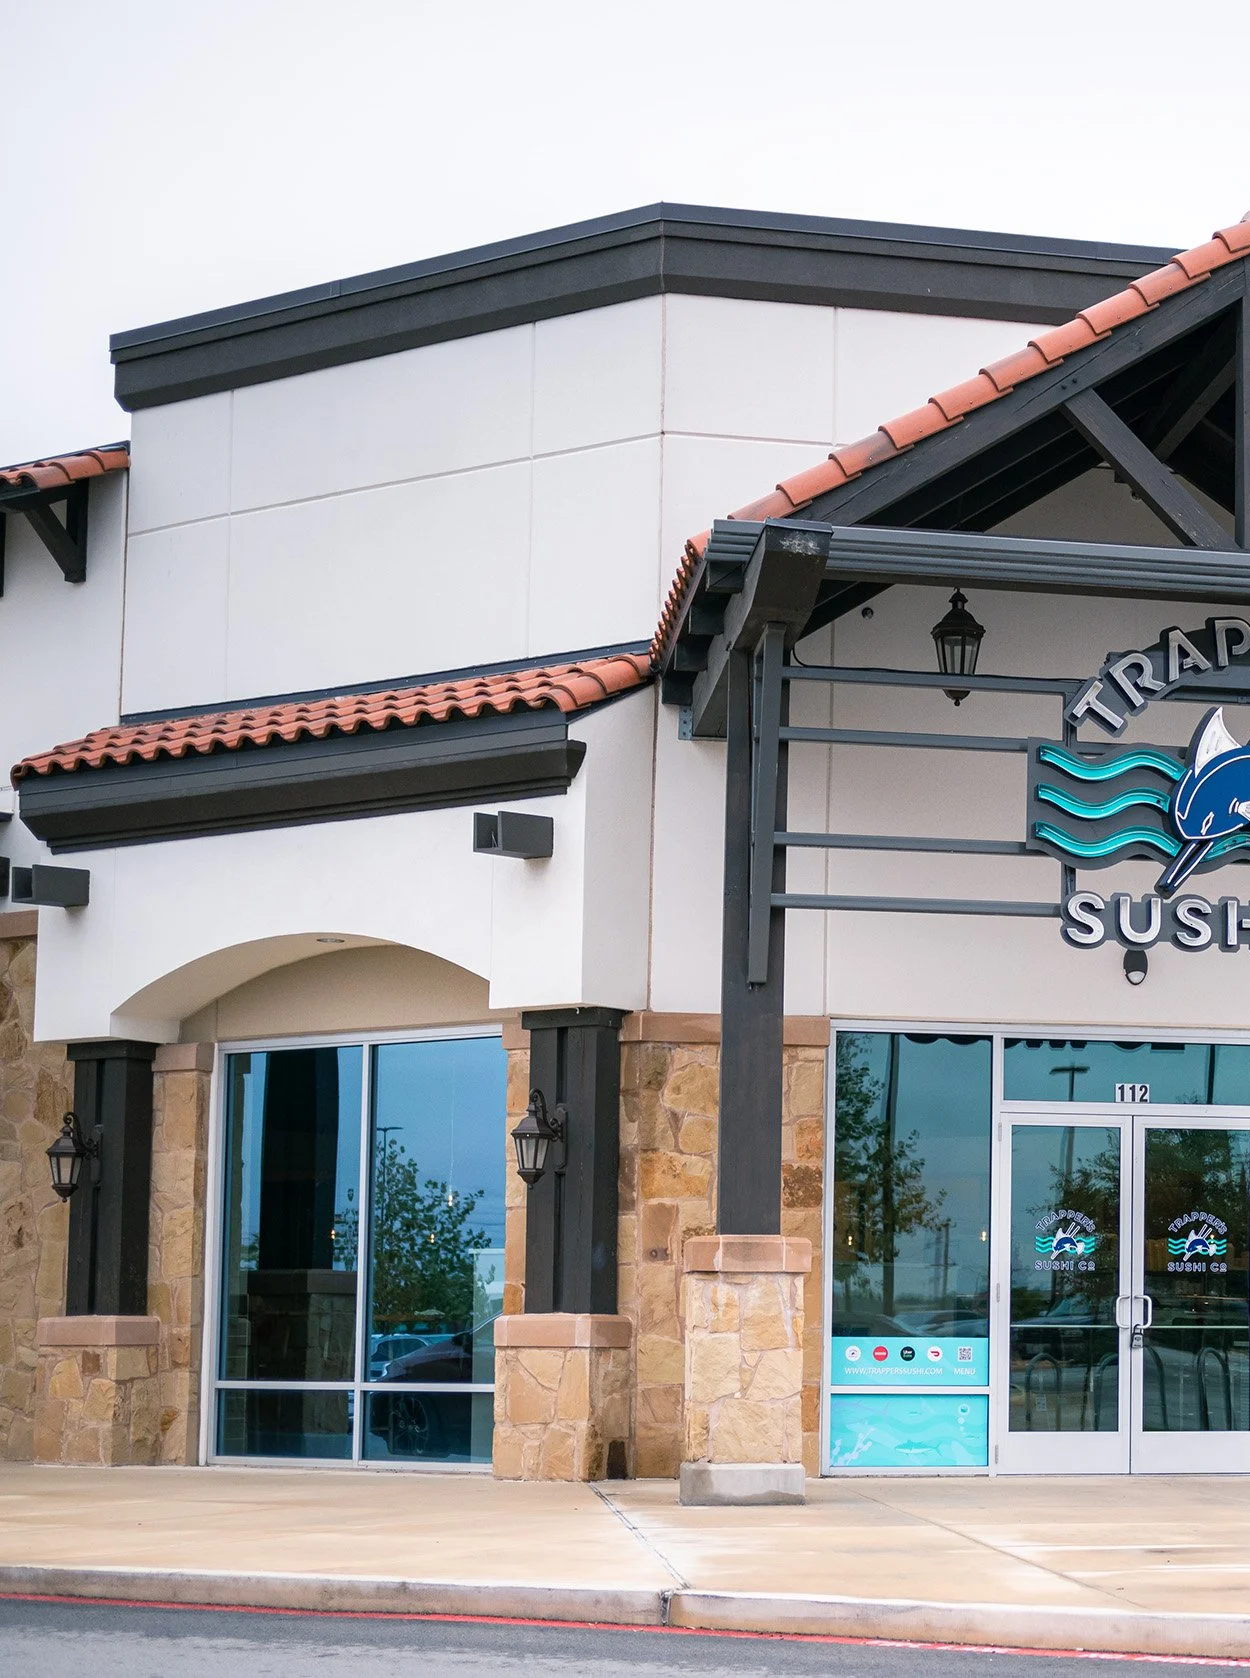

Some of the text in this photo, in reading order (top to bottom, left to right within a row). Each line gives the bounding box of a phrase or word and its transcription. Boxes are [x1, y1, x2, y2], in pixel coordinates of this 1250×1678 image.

[1117, 1084, 1149, 1103] 112
[1034, 1209, 1096, 1233] TRAPPER'S
[1167, 1211, 1228, 1235] TRAPPER'S
[1034, 1260, 1075, 1272] SUSHI
[1167, 1261, 1207, 1273] SUSHI
[844, 1366, 943, 1376] WWW.TRAPPERSSUSHI.COM
[953, 1366, 977, 1376] MENU
